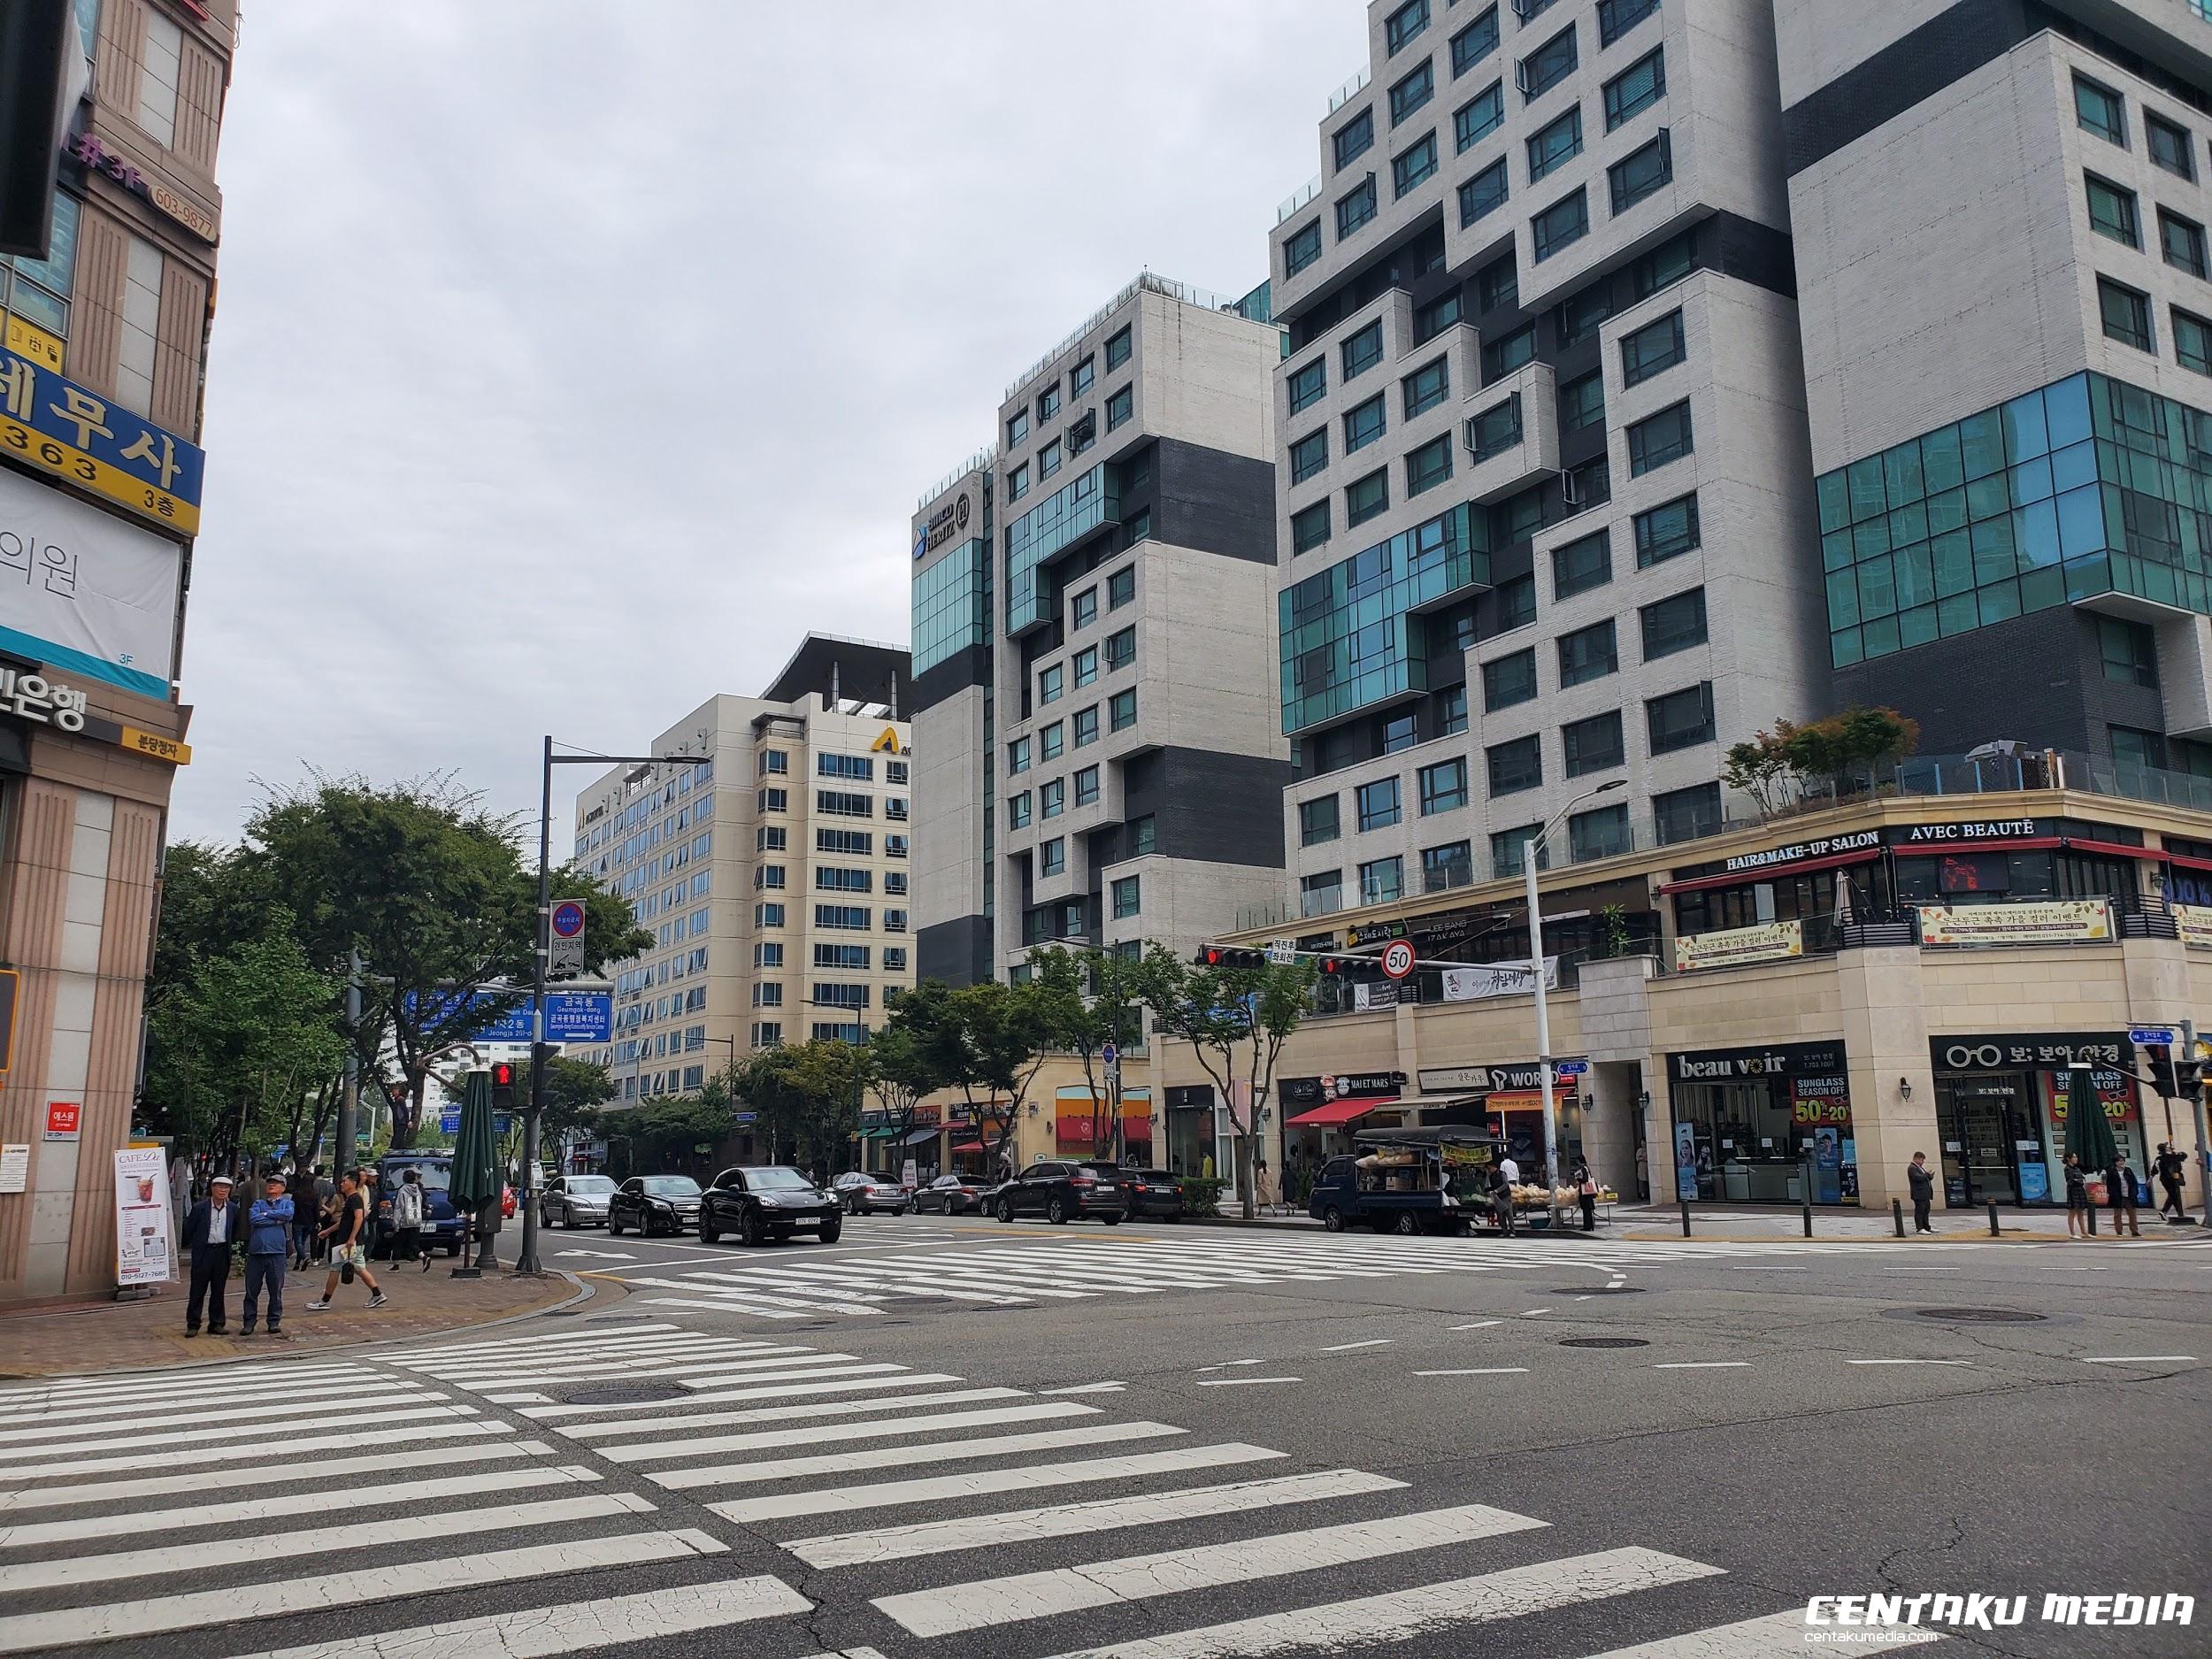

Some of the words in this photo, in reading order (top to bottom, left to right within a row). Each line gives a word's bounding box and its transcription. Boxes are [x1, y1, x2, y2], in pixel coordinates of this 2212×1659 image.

[109, 155, 142, 189] 3F
[156, 188, 212, 236] 603-9877
[143, 489, 175, 518] 3층
[119, 653, 133, 664] 3F
[1910, 825, 1957, 841] AVEC
[1727, 841, 1829, 871] HAIR&MAKE-UP
[1832, 831, 1879, 852] SALON
[1943, 917, 1980, 926] 두근두근
[2007, 915, 2026, 925] 가을
[2031, 914, 2048, 924] 컬러
[2053, 913, 2082, 922] 이벤트
[1358, 926, 1392, 943] 수제도시락
[1427, 930, 1465, 942] IZAKAYA
[554, 941, 581, 951] 견인지역
[1274, 940, 1295, 950] 직진후
[1272, 952, 1294, 964] 좌회전
[1388, 952, 1409, 968] 50
[565, 997, 594, 1007] 금곡동
[2039, 1045, 2074, 1062] 보아
[2082, 1044, 2119, 1063] 안경
[1678, 1055, 1732, 1079] beau
[1350, 1079, 1363, 1089] MAI
[1363, 1079, 1371, 1088] ET
[1371, 1078, 1389, 1088] MARS
[1510, 1071, 1560, 1087] WORD
[1797, 1078, 1845, 1088] SUNGLASS
[2102, 1080, 2123, 1090] OFF
[1798, 1087, 1829, 1096] SEASON
[53, 1111, 74, 1122] 에스원
[119, 1155, 142, 1164] CAFE
